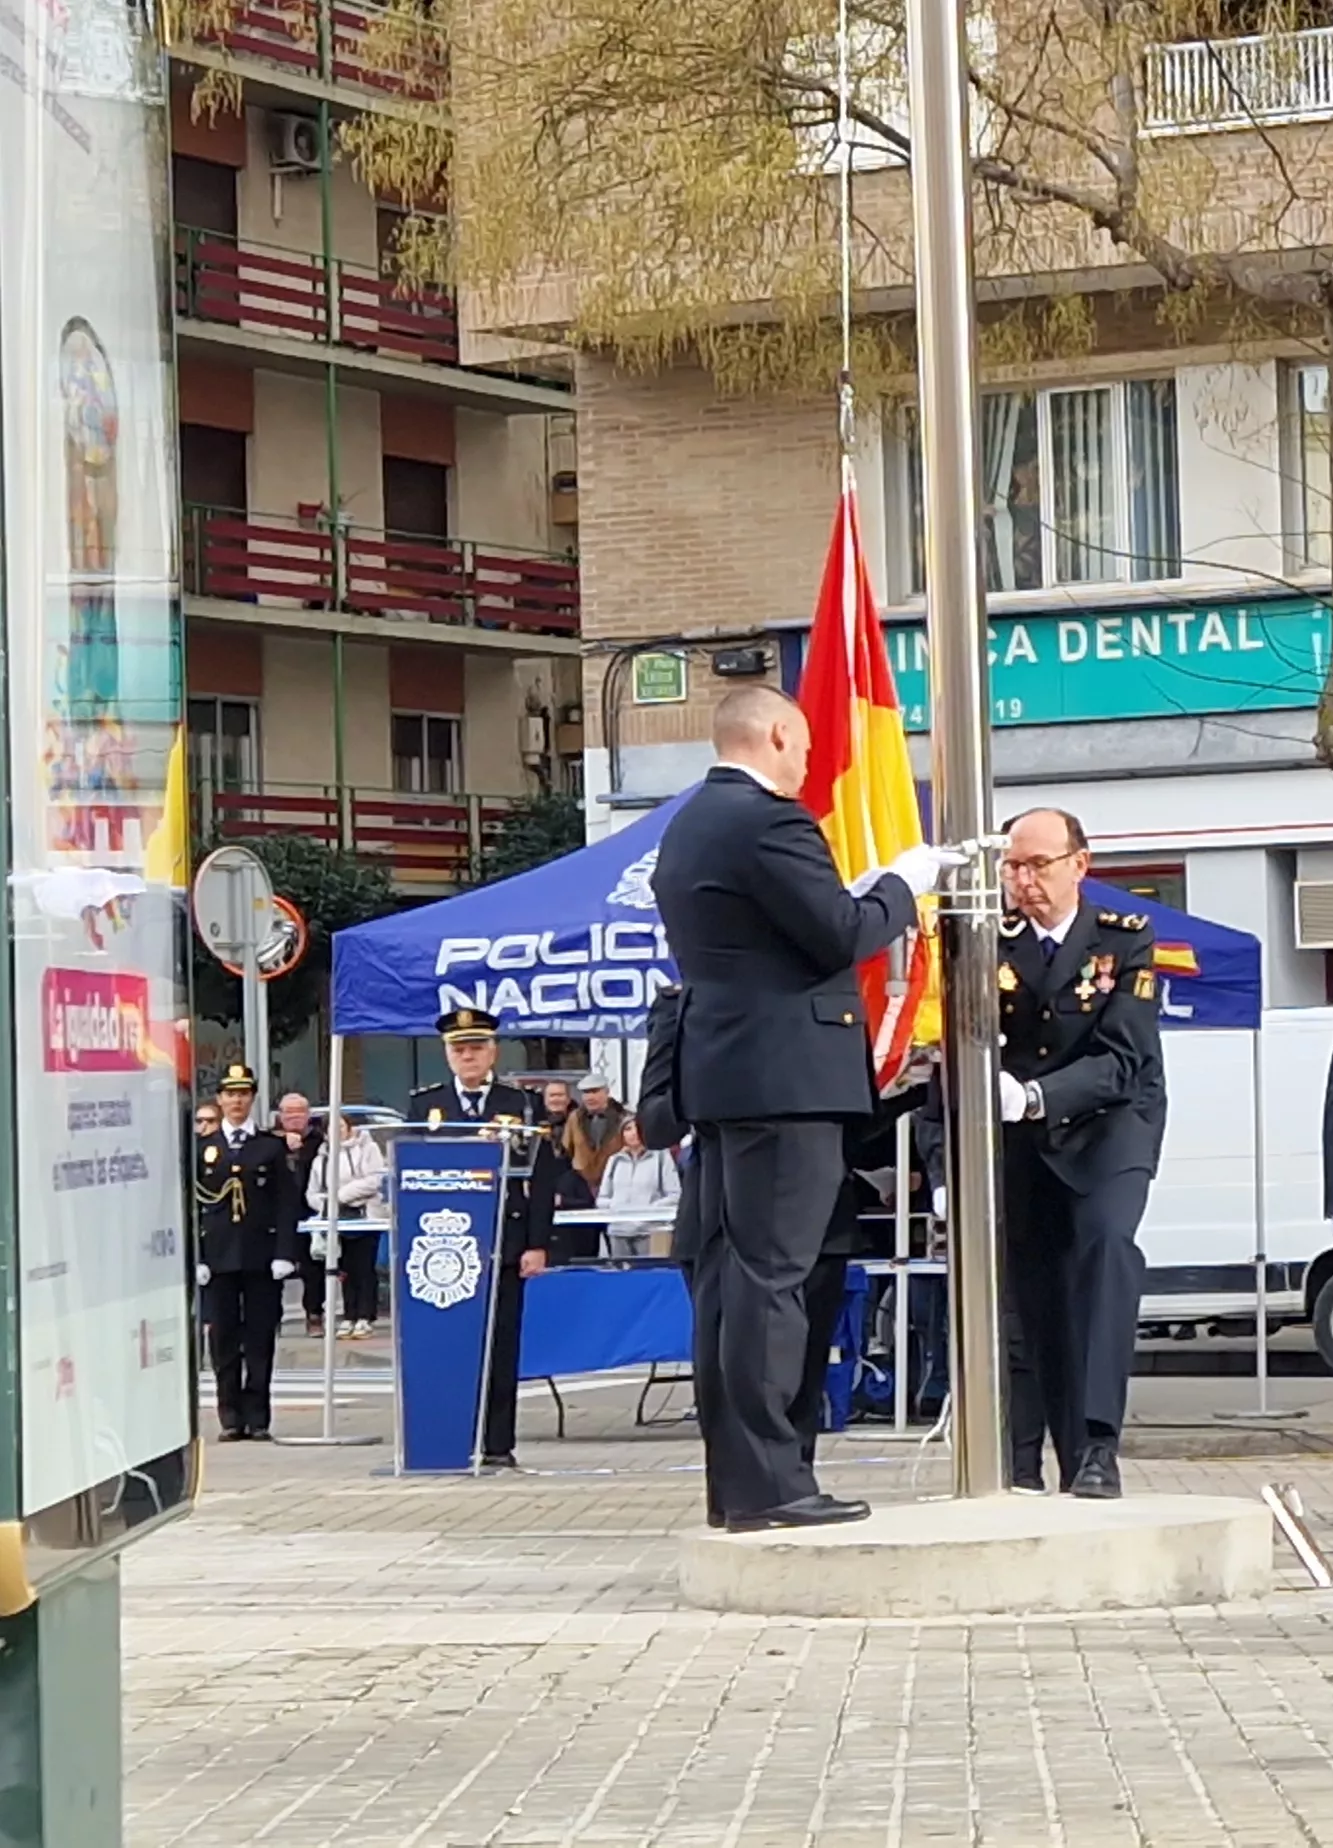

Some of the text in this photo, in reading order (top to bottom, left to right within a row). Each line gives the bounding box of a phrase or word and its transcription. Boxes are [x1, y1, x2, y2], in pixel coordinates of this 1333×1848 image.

[1058, 610, 1263, 662] DENTAL
[438, 968, 674, 1017] NACION
[401, 1180, 493, 1191] NACIONAL
